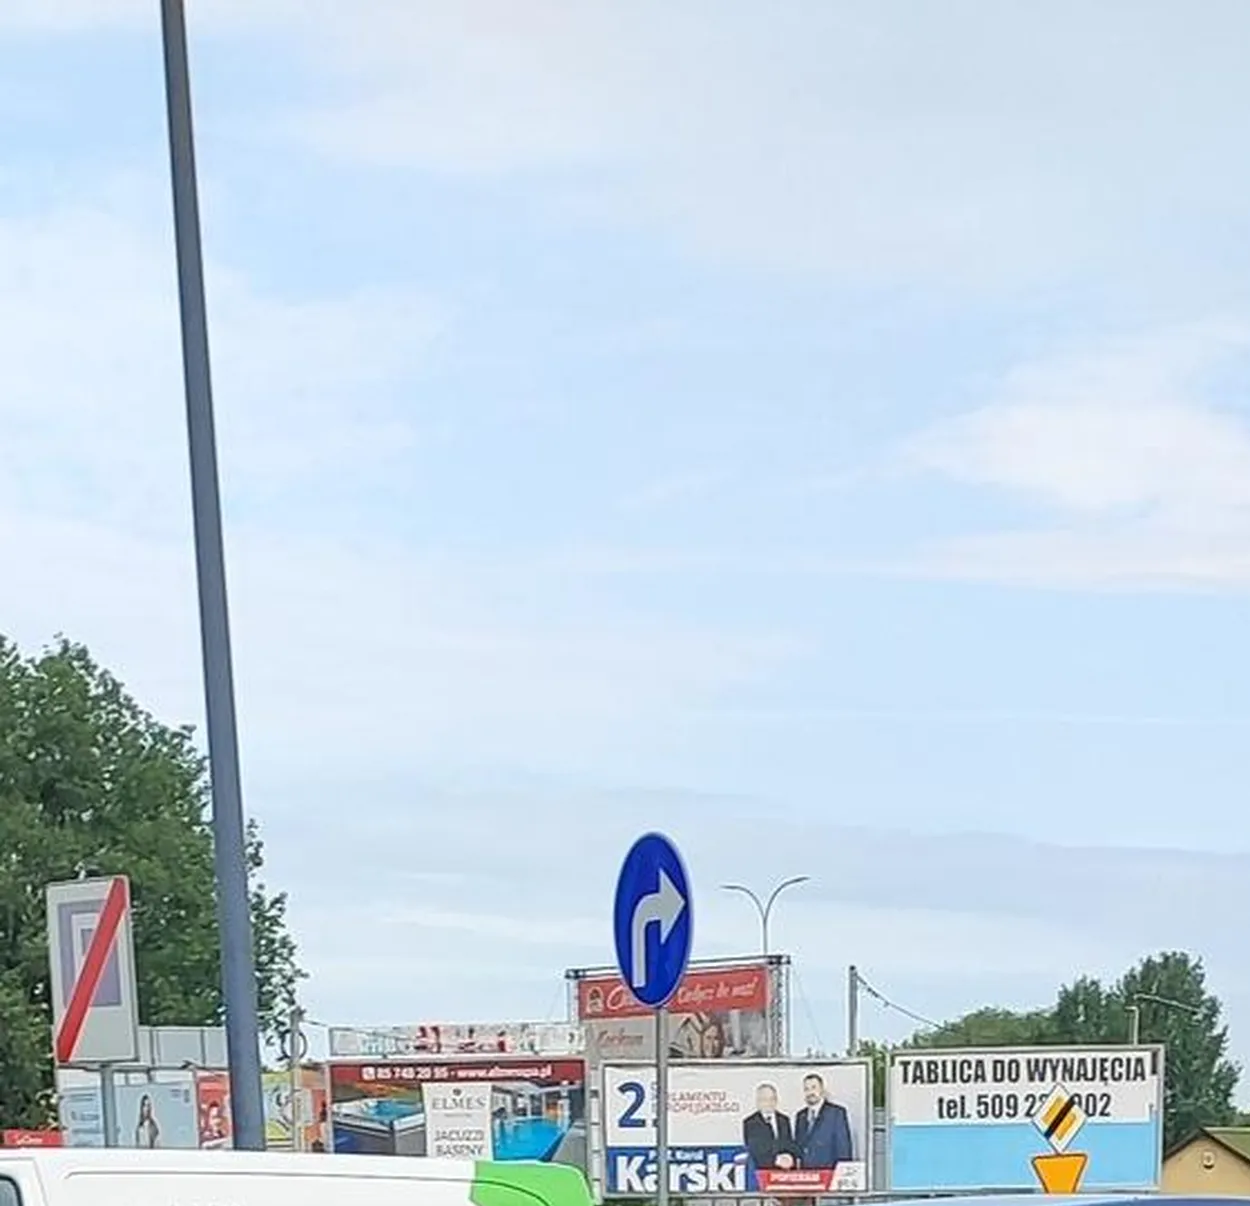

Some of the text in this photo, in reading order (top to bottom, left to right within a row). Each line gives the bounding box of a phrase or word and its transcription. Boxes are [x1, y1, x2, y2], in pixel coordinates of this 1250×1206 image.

[900, 1056, 1146, 1086] TABLICA DO WYNAJĘCIA
[432, 1097, 487, 1110] ELMES
[938, 1095, 972, 1119] tel.
[976, 1093, 1019, 1119] 509
[616, 1153, 748, 1193] Karski
